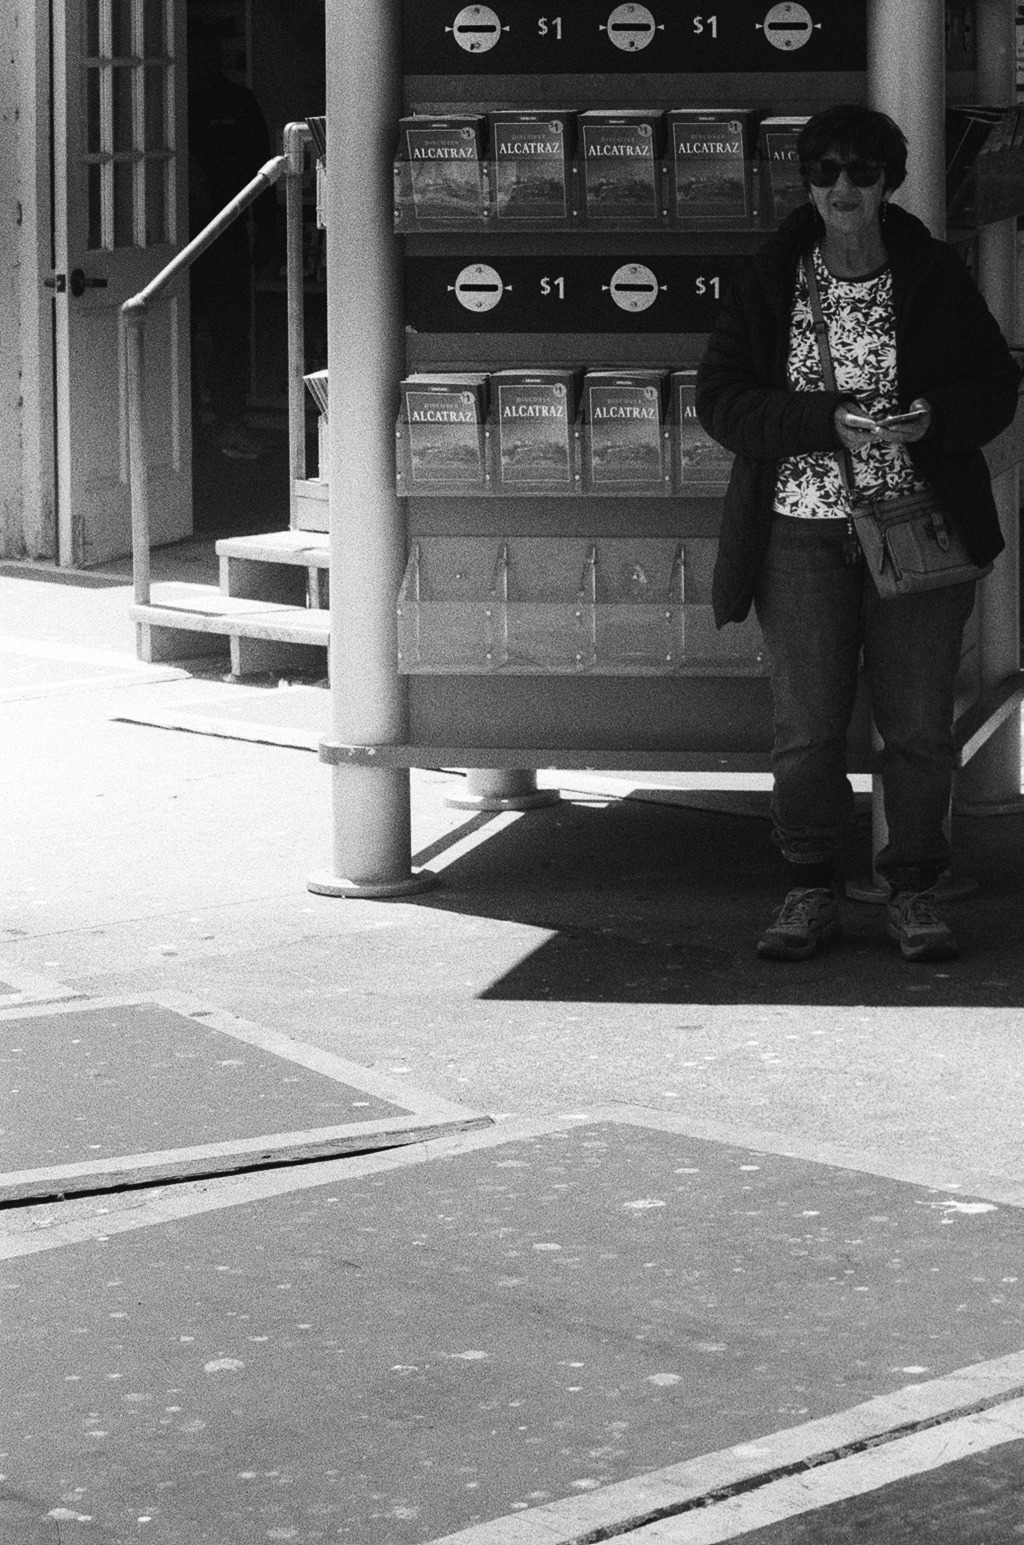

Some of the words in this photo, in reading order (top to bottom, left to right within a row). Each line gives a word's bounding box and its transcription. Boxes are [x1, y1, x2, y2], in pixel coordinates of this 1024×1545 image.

[537, 16, 562, 40] $1
[692, 15, 718, 39] $1
[413, 147, 474, 160] ALCATRAZ
[499, 142, 561, 155] ALCATRAZ
[588, 144, 650, 157] ALCATRAZ
[677, 141, 741, 154] ALCATRAZ
[539, 275, 565, 300] $1
[694, 275, 720, 300] $1
[412, 410, 474, 423] ALCATRAZ
[503, 405, 564, 418] ALCATRAZ
[594, 406, 655, 419] ALCATRAZ
